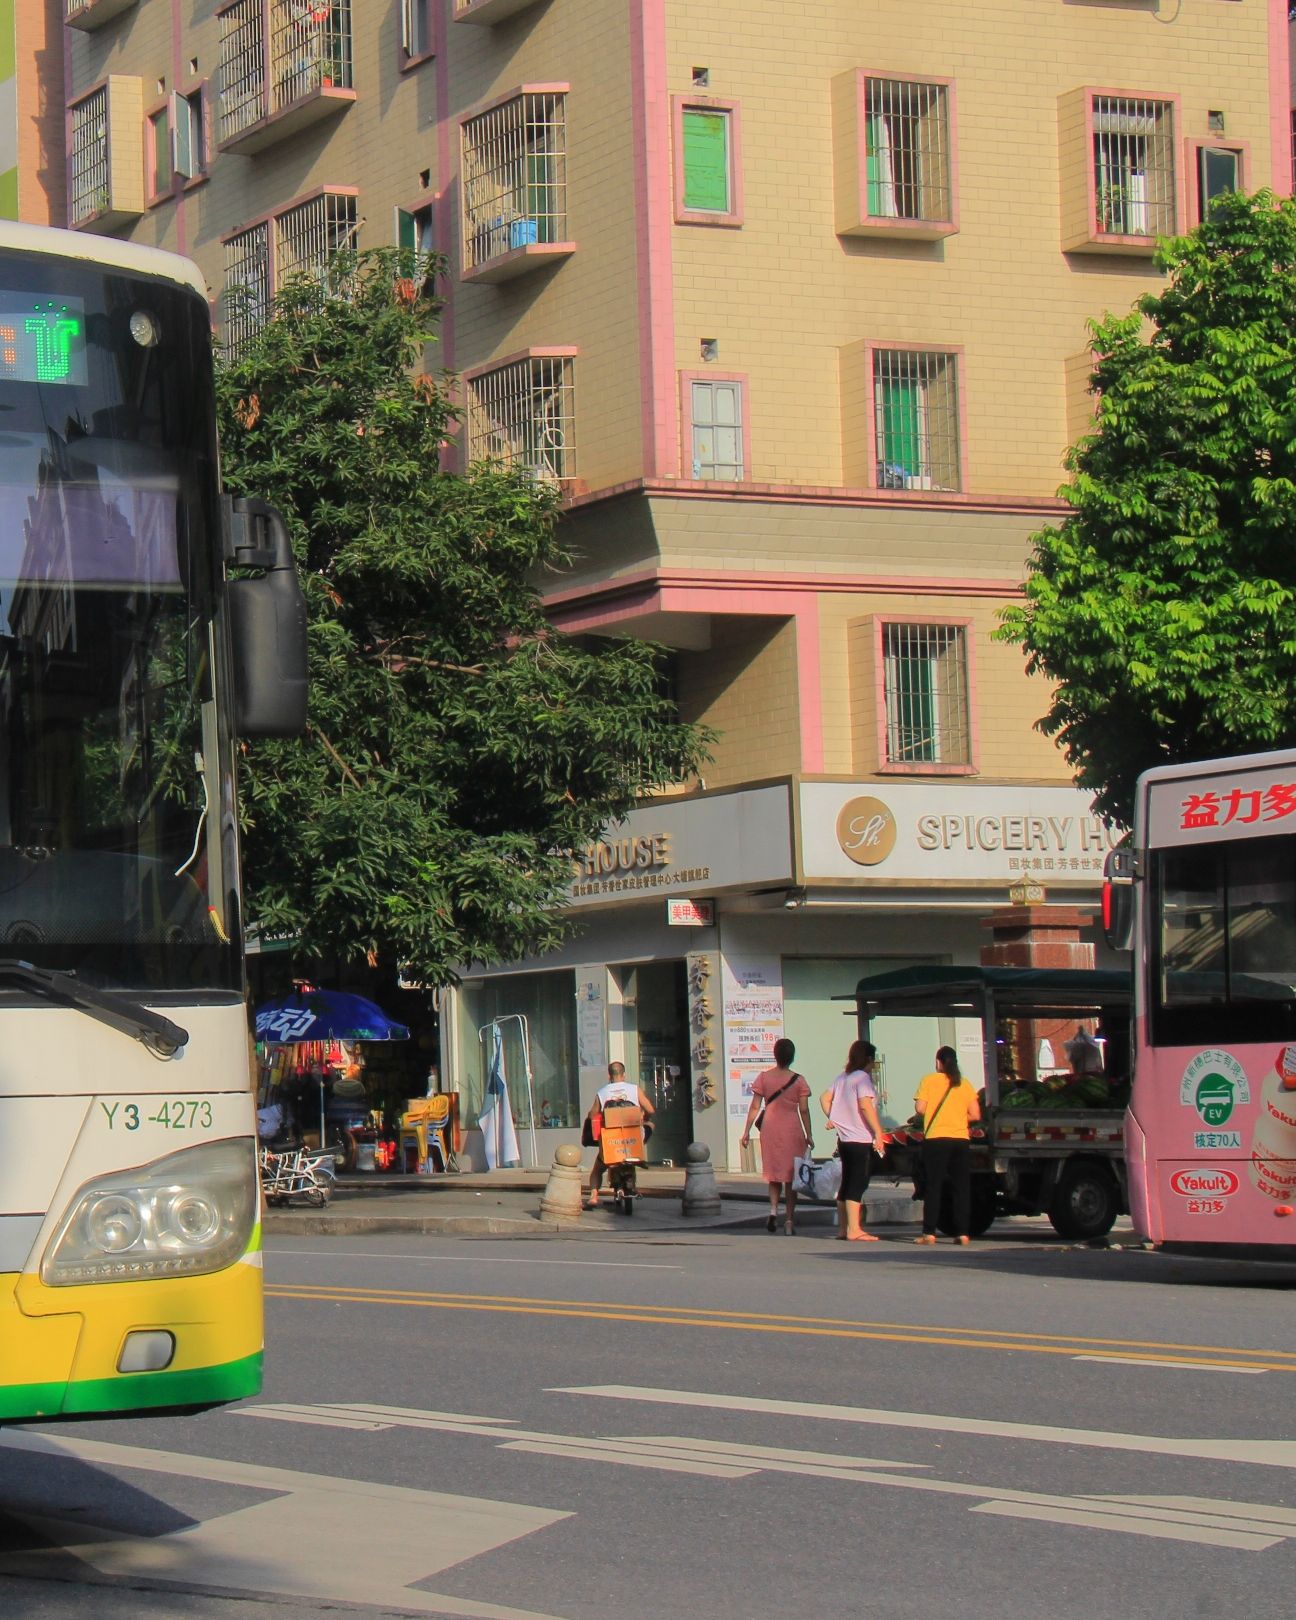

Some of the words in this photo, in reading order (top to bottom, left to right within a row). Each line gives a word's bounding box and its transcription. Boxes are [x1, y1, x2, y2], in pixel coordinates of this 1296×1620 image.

[1180, 783, 1296, 829] 益力多
[917, 815, 1074, 851] SPICERY
[585, 832, 671, 877] HOUSE
[1208, 1108, 1223, 1119] EV
[1195, 1132, 1240, 1148] 核定70人
[1181, 1176, 1229, 1191] Yakult
[1187, 1200, 1225, 1214] 益力多
